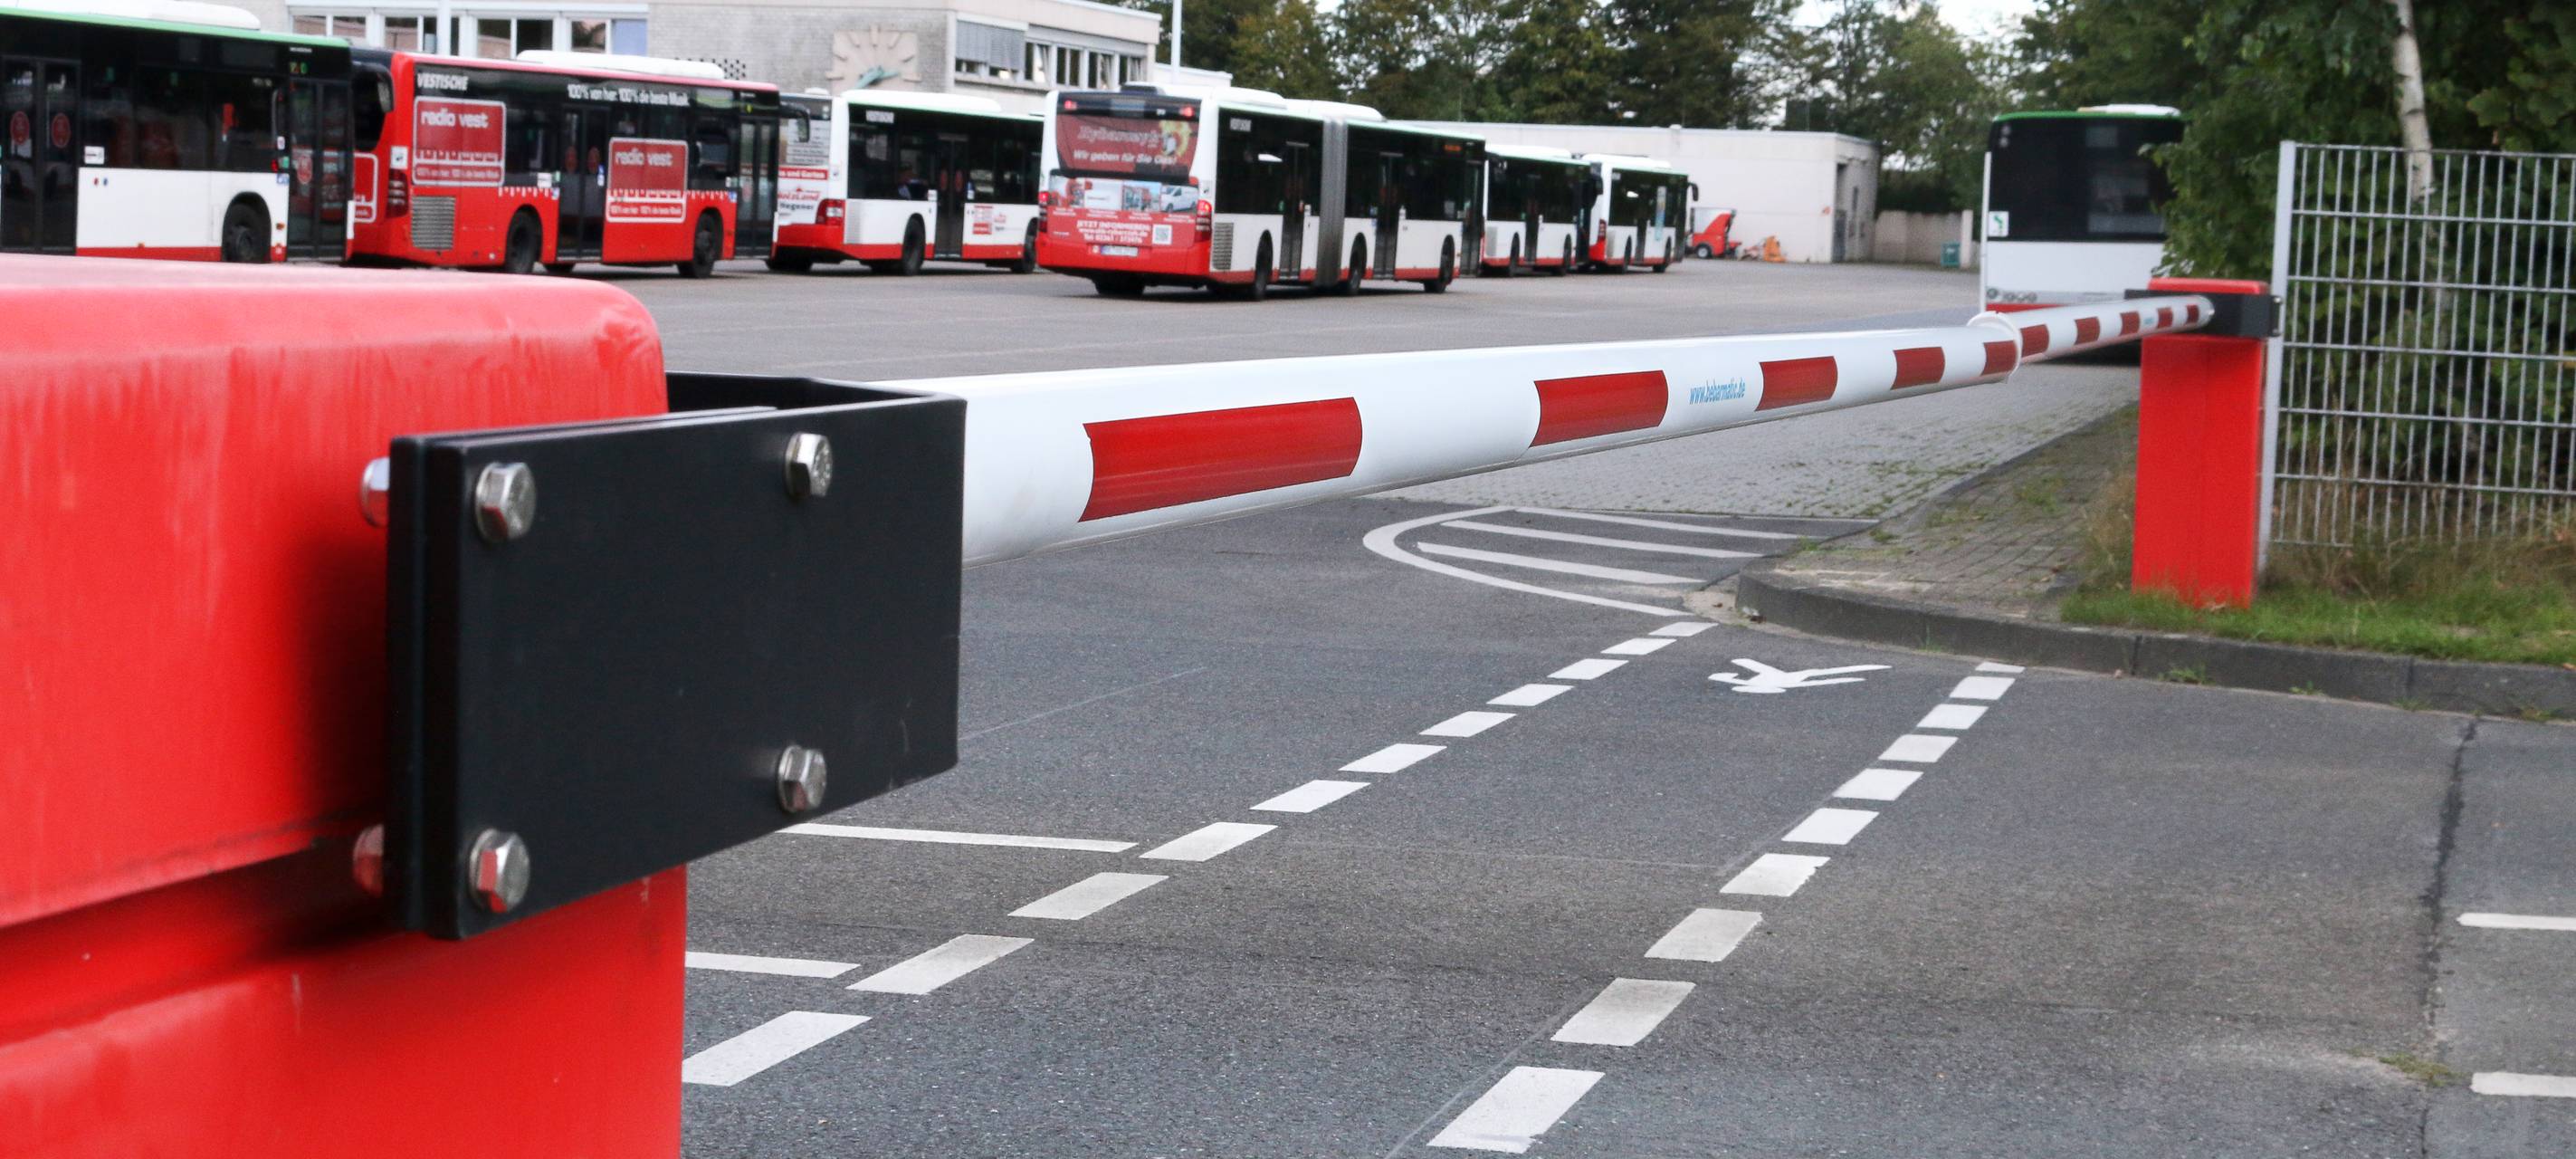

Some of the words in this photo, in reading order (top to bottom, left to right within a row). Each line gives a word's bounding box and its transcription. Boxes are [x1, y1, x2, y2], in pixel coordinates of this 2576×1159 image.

[417, 72, 468, 91] VESTISCHE
[421, 108, 456, 127] radio
[458, 111, 489, 129] vest
[615, 148, 644, 167] radio
[646, 151, 673, 167] vest
